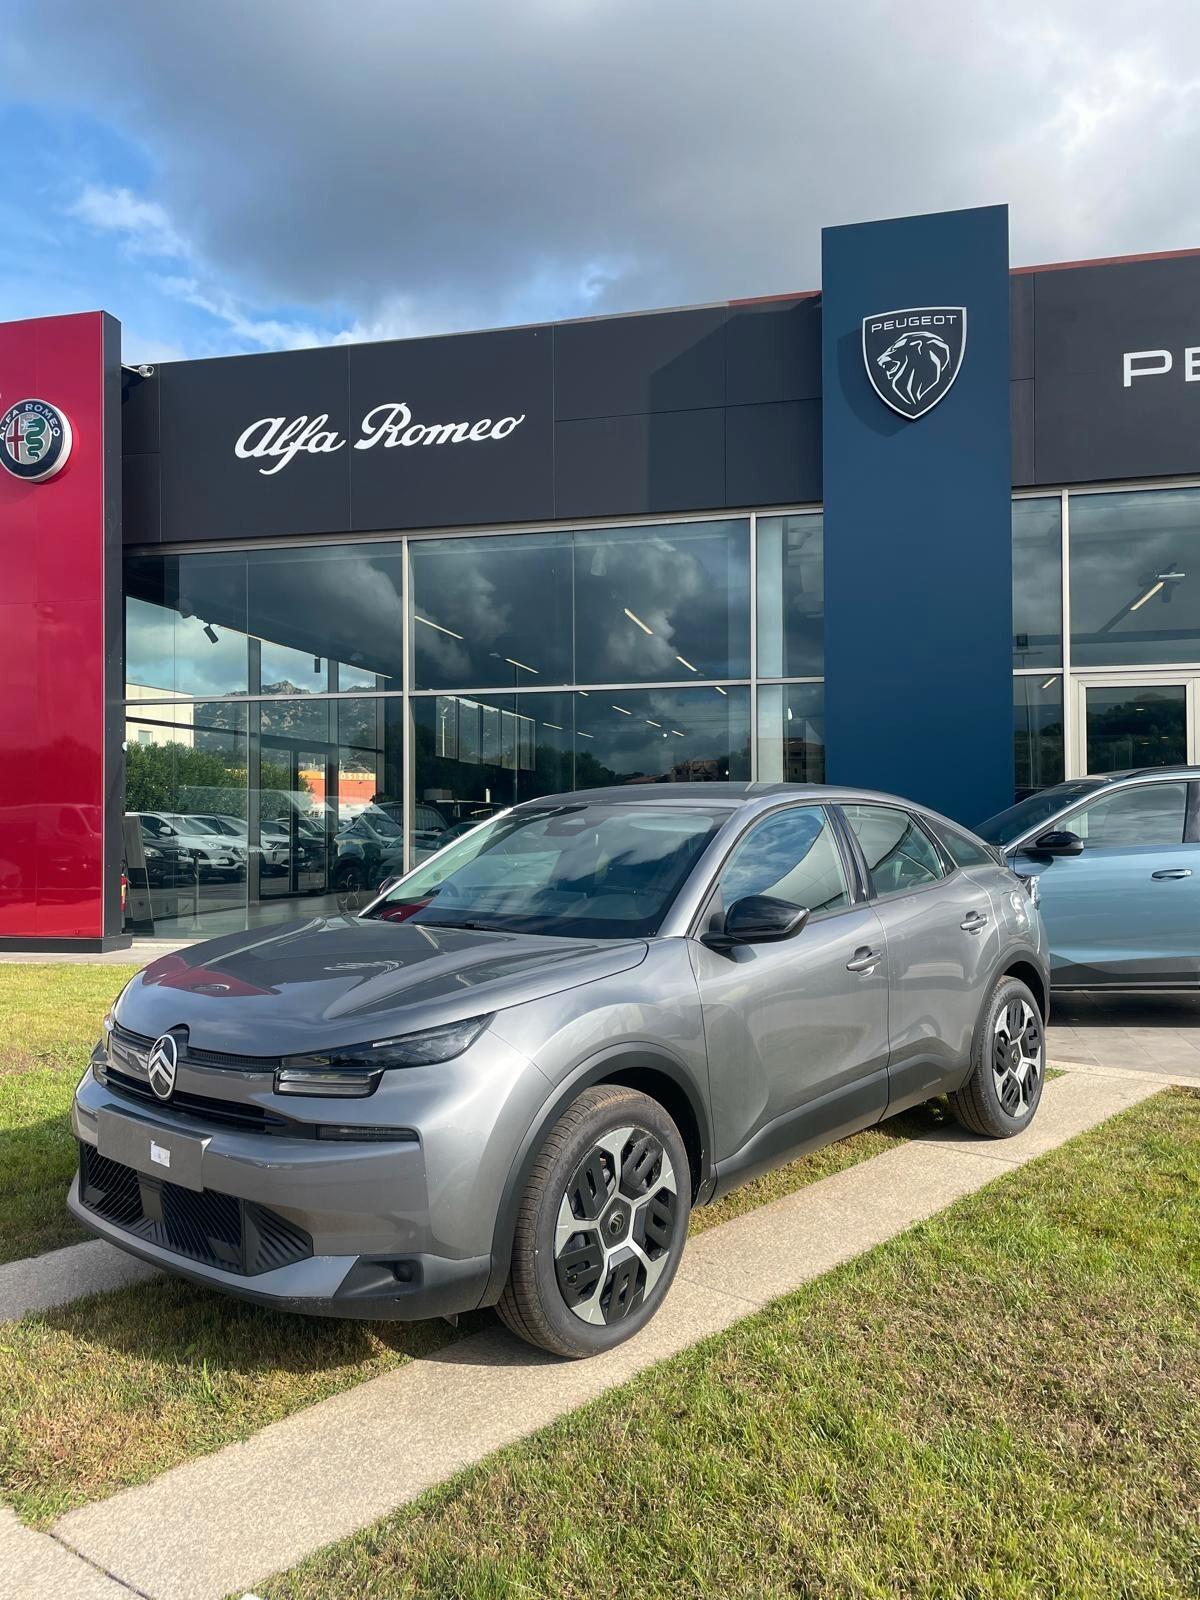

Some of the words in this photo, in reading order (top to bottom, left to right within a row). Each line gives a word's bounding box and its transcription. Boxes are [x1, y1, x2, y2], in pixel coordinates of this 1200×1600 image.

[871, 315, 957, 333] PEUGEOT
[0, 408, 20, 441] ALFA
[24, 403, 61, 437] ROMEO
[234, 413, 346, 476] Alfa
[353, 402, 526, 450] Romeo
